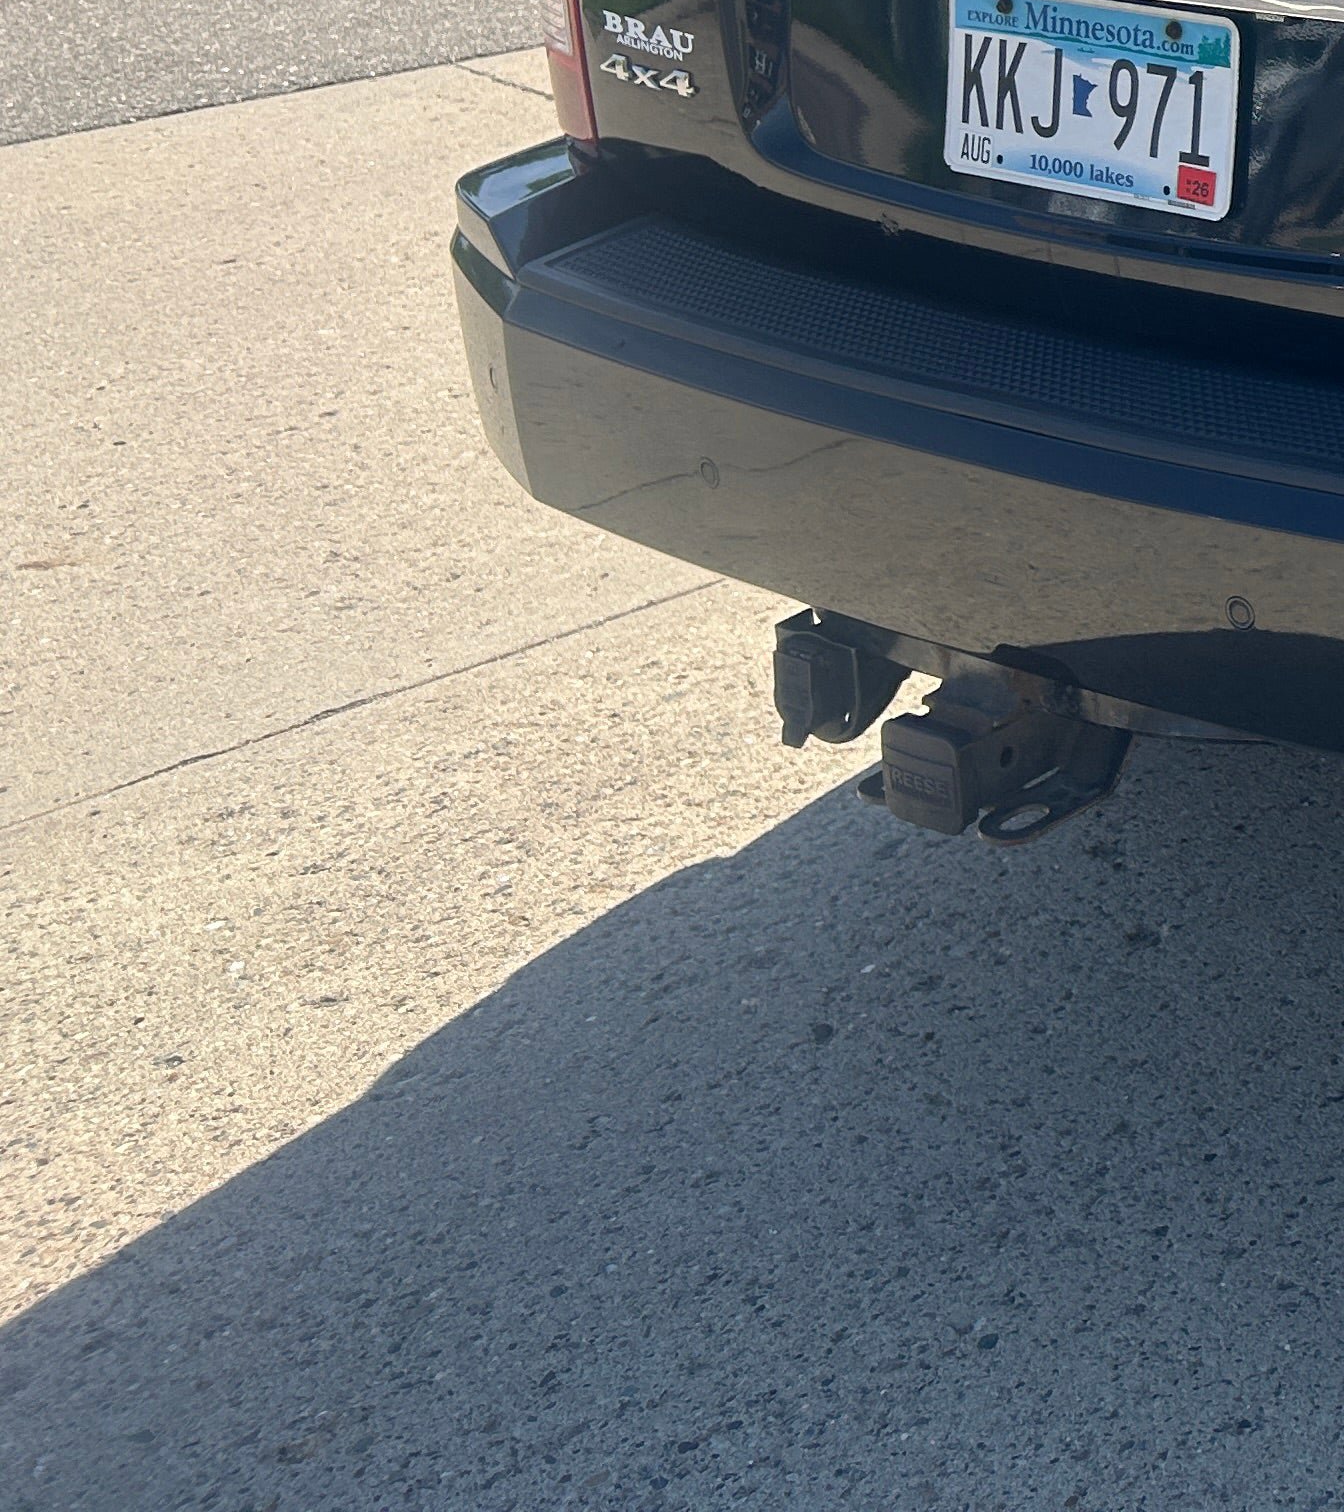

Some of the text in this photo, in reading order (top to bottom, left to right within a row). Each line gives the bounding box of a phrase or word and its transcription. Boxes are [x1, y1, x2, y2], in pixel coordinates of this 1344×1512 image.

[602, 9, 694, 54] BRAU
[967, 9, 1018, 28] EXPLORE
[616, 34, 683, 62] ARLINGTON
[961, 34, 1210, 167] KKJ 971
[961, 133, 991, 164] AUG
[1029, 154, 1134, 188] 10,000 lakes
[1192, 180, 1209, 198] 26
[892, 768, 948, 800] REESE
